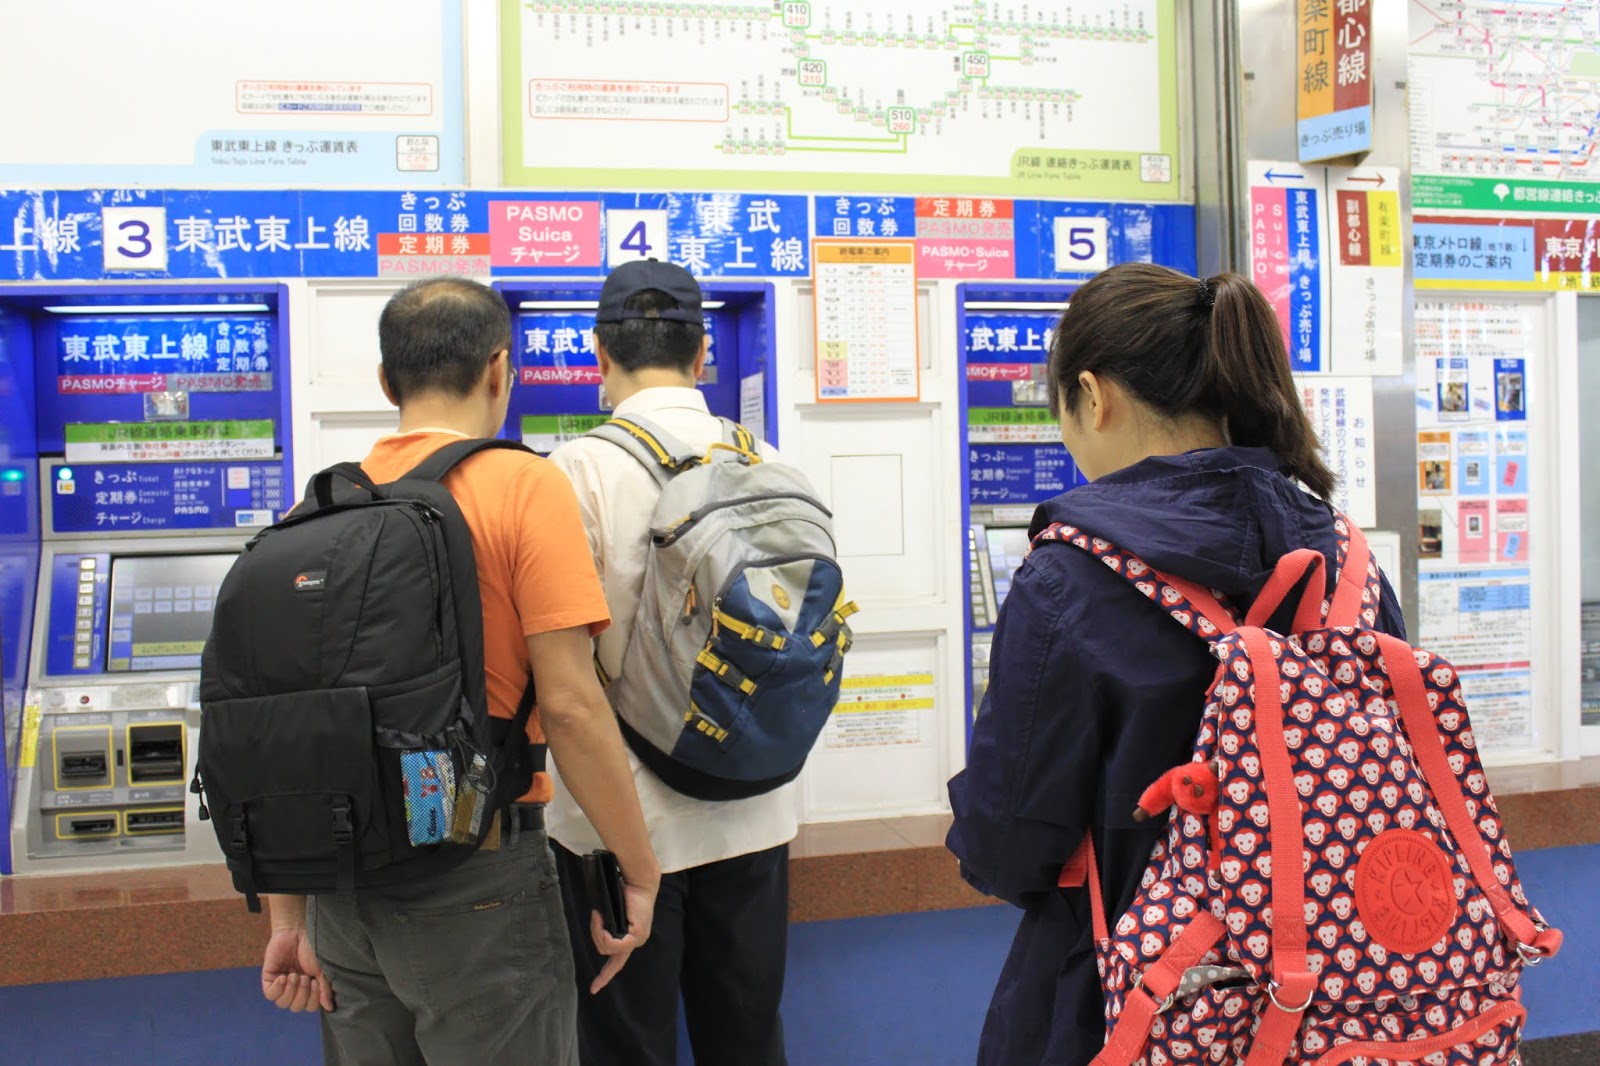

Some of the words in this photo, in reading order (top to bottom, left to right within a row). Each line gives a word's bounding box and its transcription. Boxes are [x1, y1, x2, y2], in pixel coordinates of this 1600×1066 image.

[786, 4, 807, 15] 410
[802, 63, 823, 73] 420
[967, 55, 986, 66] 450
[891, 110, 912, 121] 510
[211, 140, 277, 153] 東武東上線
[282, 140, 359, 154] きっぷ運賃表
[1016, 156, 1041, 168] JR線
[400, 192, 467, 210] きっぷ
[834, 196, 896, 216] きっぷ
[933, 198, 997, 218] 定期券
[398, 213, 470, 233] 回数券
[506, 206, 583, 222] PASMO
[700, 198, 781, 234] 東武
[174, 215, 372, 253] 東武東上線
[518, 226, 572, 242] Suica
[833, 218, 899, 236] 回数券
[916, 219, 1012, 236] PASMO発売
[1295, 190, 1311, 265] 東武東上線
[1345, 198, 1362, 258] 副都心線
[117, 220, 153, 260] 3
[398, 235, 470, 254] 定期券
[619, 220, 653, 257] 4
[1068, 227, 1096, 260] 5
[1254, 203, 1268, 274] PASMO
[1272, 204, 1285, 275] Suica
[510, 244, 580, 264] チャージ
[675, 236, 805, 272] 東上線
[922, 246, 1010, 258] PASMO・Suica
[1415, 252, 1512, 270] 定期券のご案内
[380, 259, 489, 274] PASMO発売
[945, 259, 988, 272] チャージ
[1299, 275, 1313, 363] きっぷ売り場
[62, 332, 209, 364] 東武東上線
[216, 338, 269, 355] 回数券
[964, 327, 1054, 353] 武東上
[216, 356, 270, 373] 定期券
[62, 376, 164, 390] PASMOチャージ
[1335, 388, 1349, 513] 武蔵野線のりかえのきっぷ
[1354, 418, 1366, 488] お知らせ
[970, 468, 1006, 482] 定期券
[95, 490, 137, 506] 定期券
[970, 487, 1010, 500] チャージ
[96, 510, 142, 526] チャージ
[174, 506, 210, 515] PASMO
